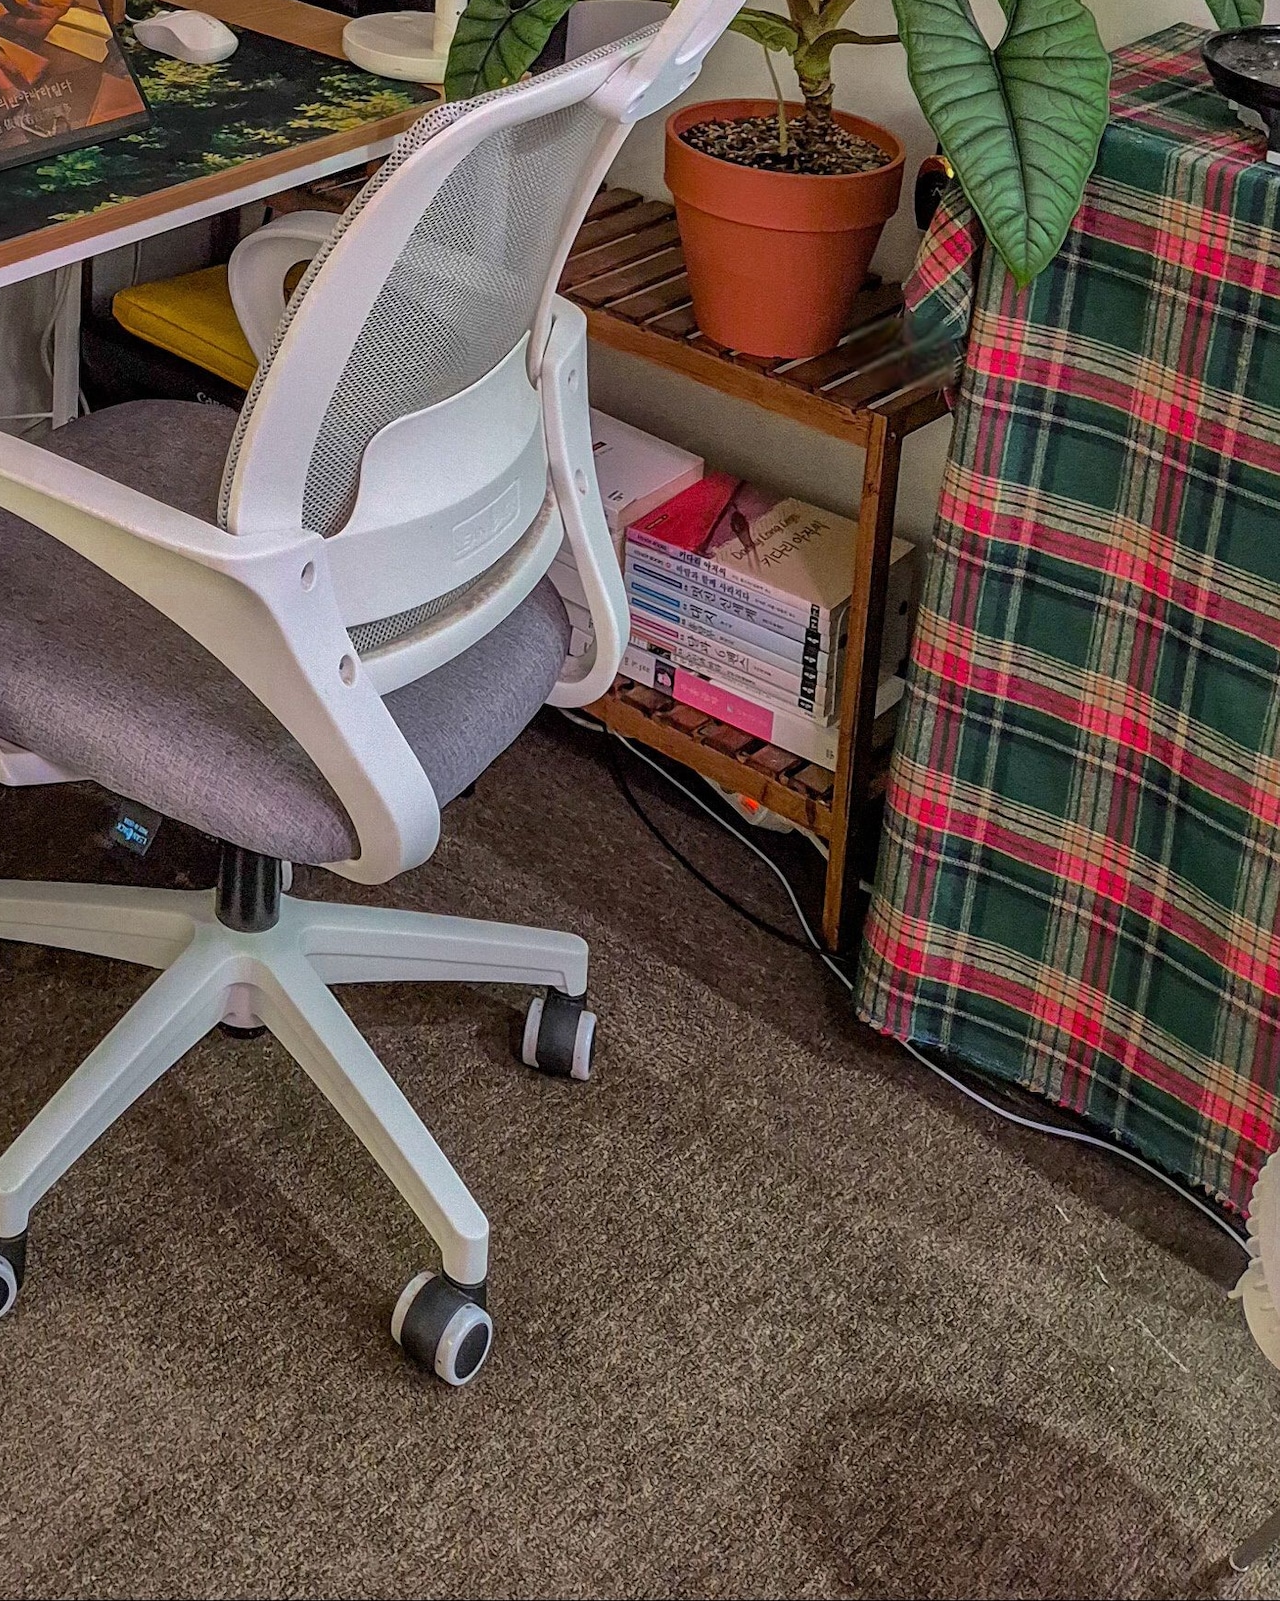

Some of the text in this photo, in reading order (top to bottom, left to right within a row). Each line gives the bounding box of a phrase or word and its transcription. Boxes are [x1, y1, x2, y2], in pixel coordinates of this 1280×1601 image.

[761, 520, 832, 568] 키다리 아저씨
[678, 551, 702, 568] 키다리
[703, 560, 727, 577] 아저씨
